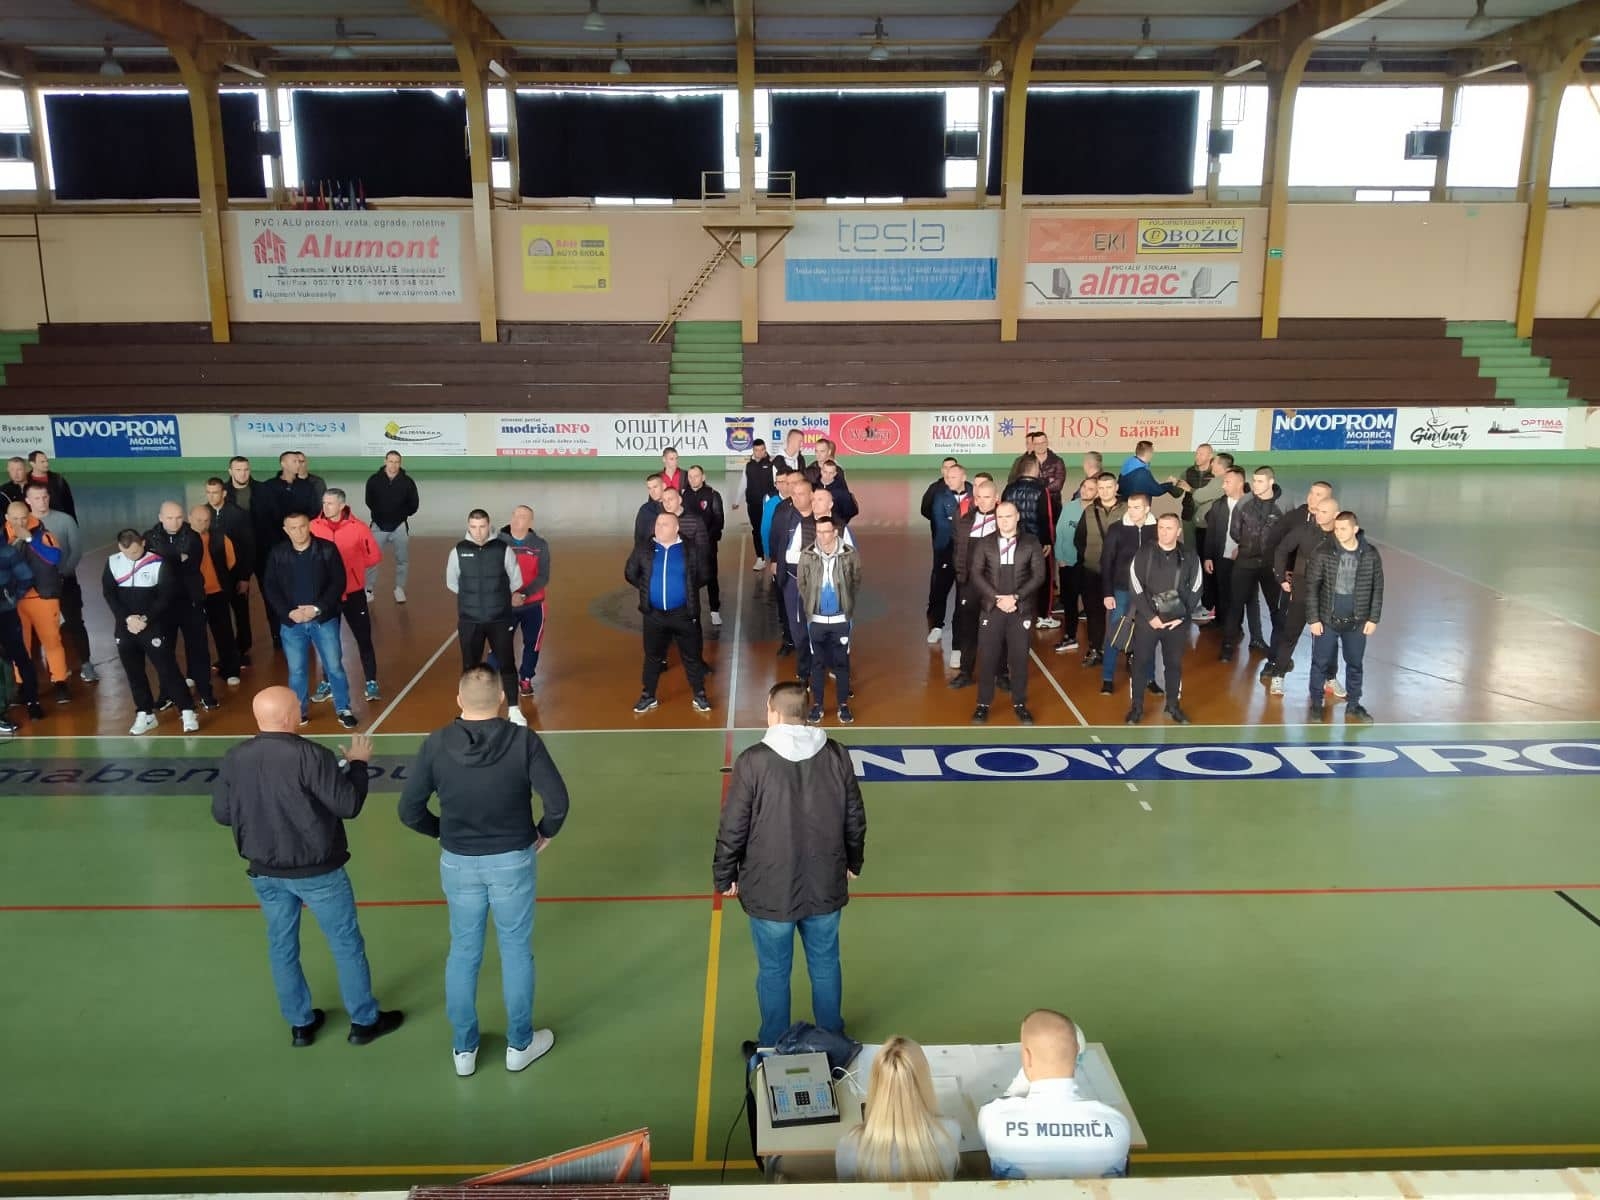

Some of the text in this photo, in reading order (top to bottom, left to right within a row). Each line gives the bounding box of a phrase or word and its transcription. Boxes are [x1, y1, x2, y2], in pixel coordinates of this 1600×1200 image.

[254, 218, 274, 226] PVC
[282, 218, 302, 226] ALU
[838, 214, 945, 252] tesla
[1170, 226, 1238, 242] BOŽIĆ
[297, 233, 440, 259] Alumont
[331, 265, 398, 273] VUKOSAVLJE
[1079, 266, 1181, 296] almac
[377, 288, 457, 297] www.alumont.net
[614, 419, 709, 434] ОПШТИНА
[774, 416, 829, 427] Auto Škola
[935, 415, 989, 423] TRGOVINA
[1275, 413, 1395, 431] NOVOPROM
[54, 420, 175, 438] NOVOPROM
[501, 422, 590, 434] modričaINFO
[932, 424, 990, 440] RAZONODA
[1346, 430, 1392, 439] MODRIČA
[130, 436, 176, 446] MODRIČA
[615, 436, 709, 452] МОДРИЧА
[1006, 1119, 1114, 1138] PS MODRIČA
